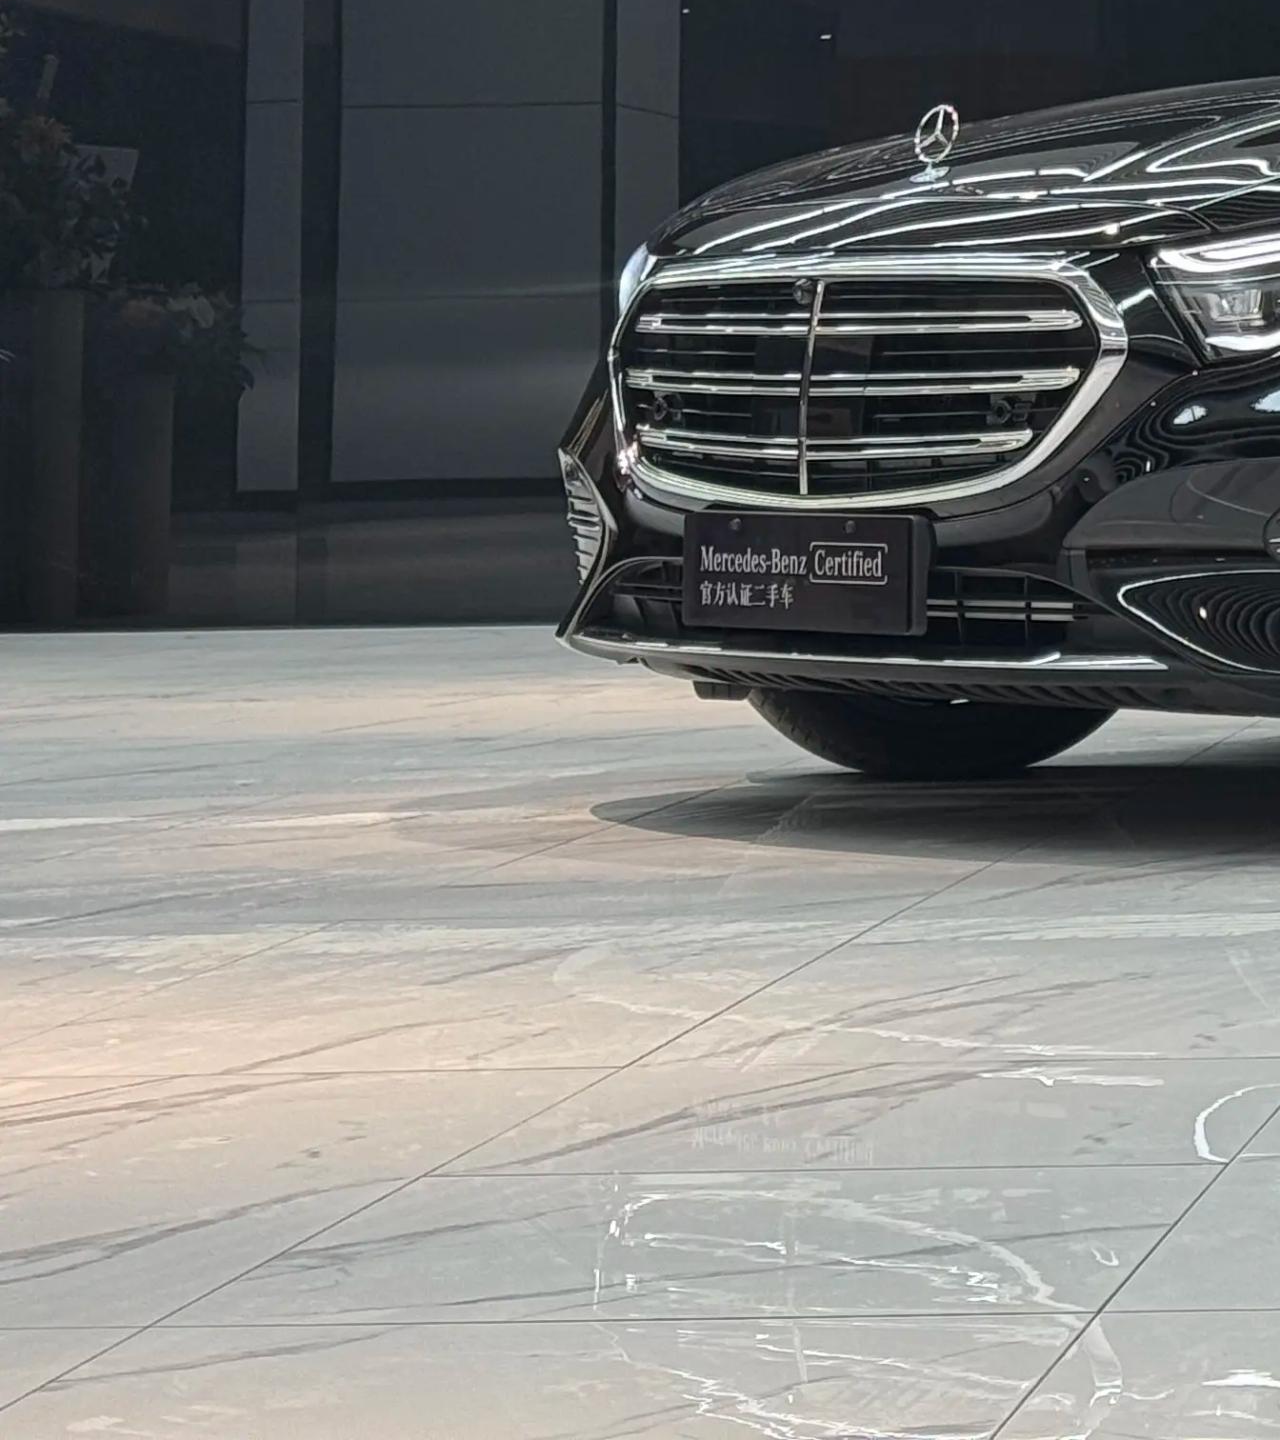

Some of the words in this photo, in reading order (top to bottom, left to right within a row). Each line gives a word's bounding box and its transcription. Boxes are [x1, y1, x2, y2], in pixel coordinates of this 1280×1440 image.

[700, 545, 808, 576] Mercedes-Benz
[814, 549, 883, 578] Certified
[700, 580, 795, 609] 官方认证二手车
